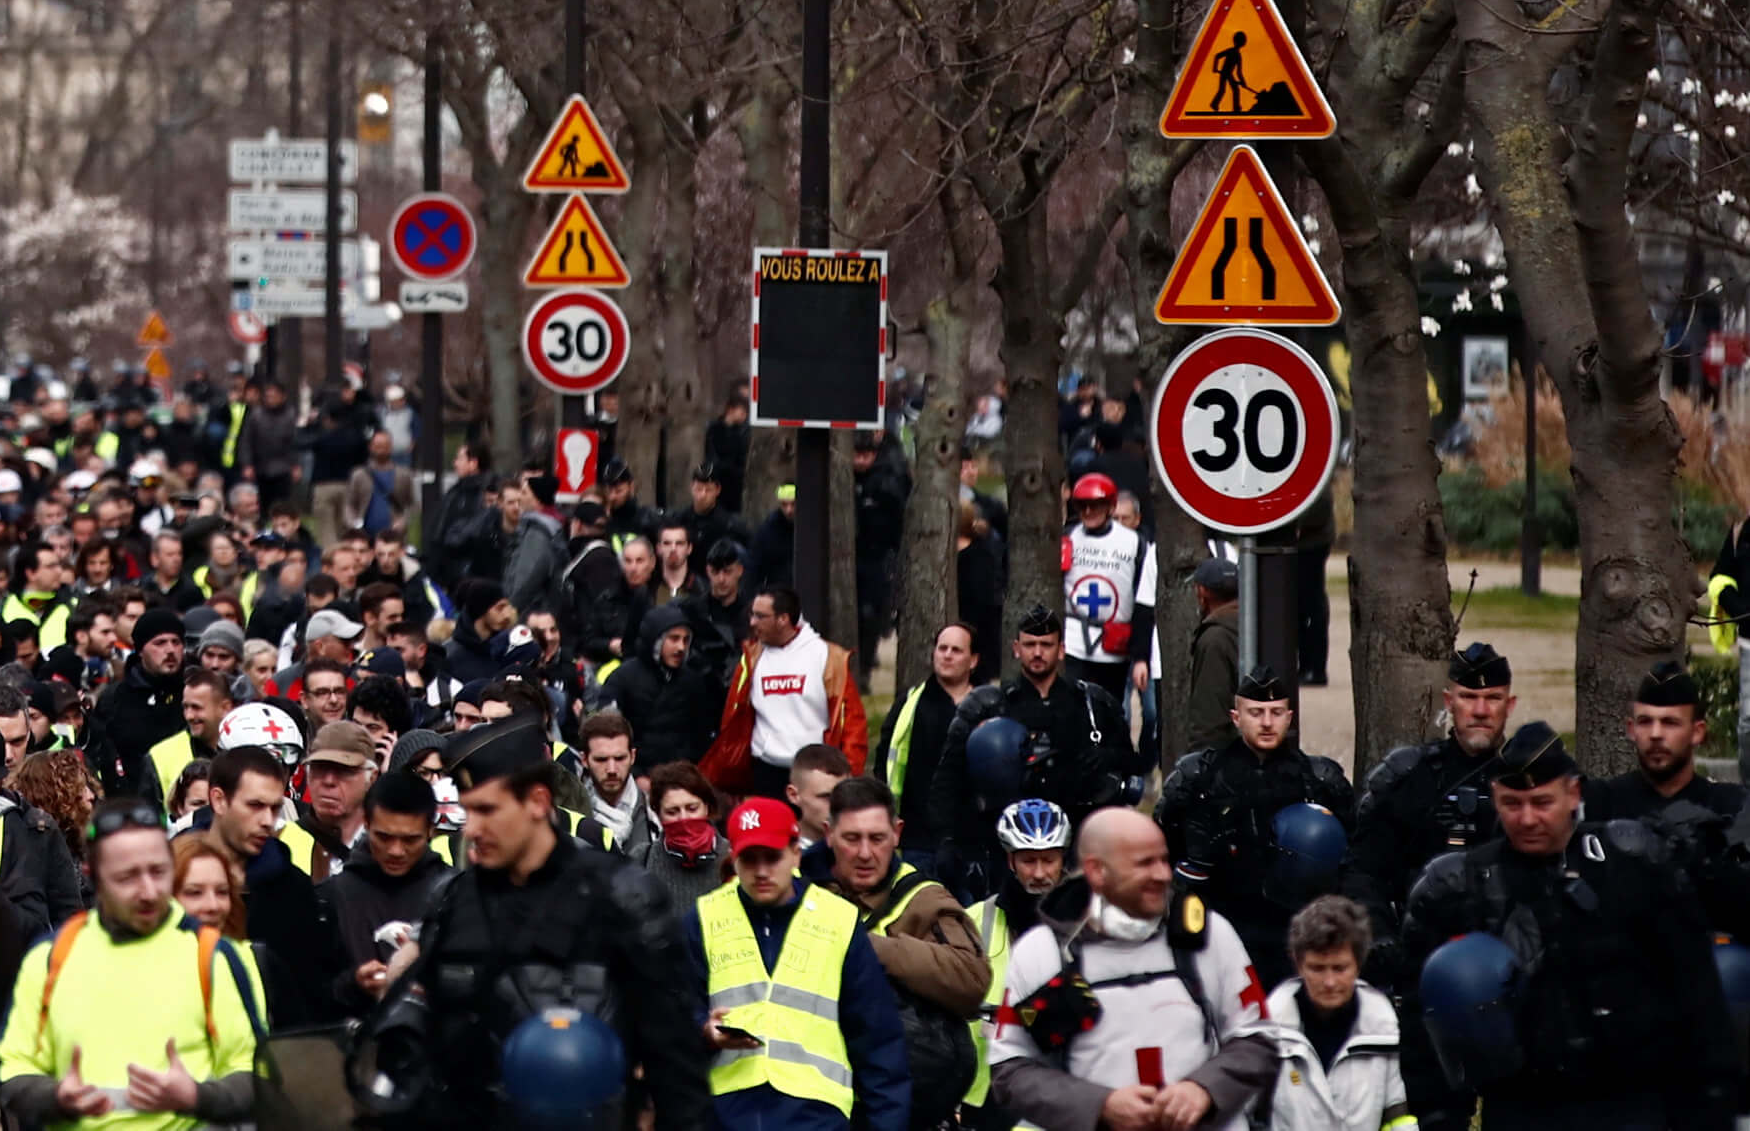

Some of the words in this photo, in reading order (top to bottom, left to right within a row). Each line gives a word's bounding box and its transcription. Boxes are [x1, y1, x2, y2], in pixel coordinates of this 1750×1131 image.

[761, 257, 802, 280] VOUS
[806, 259, 865, 282] ROULEZ
[868, 260, 879, 282] A
[547, 319, 607, 363] 30
[1191, 388, 1298, 473] 30
